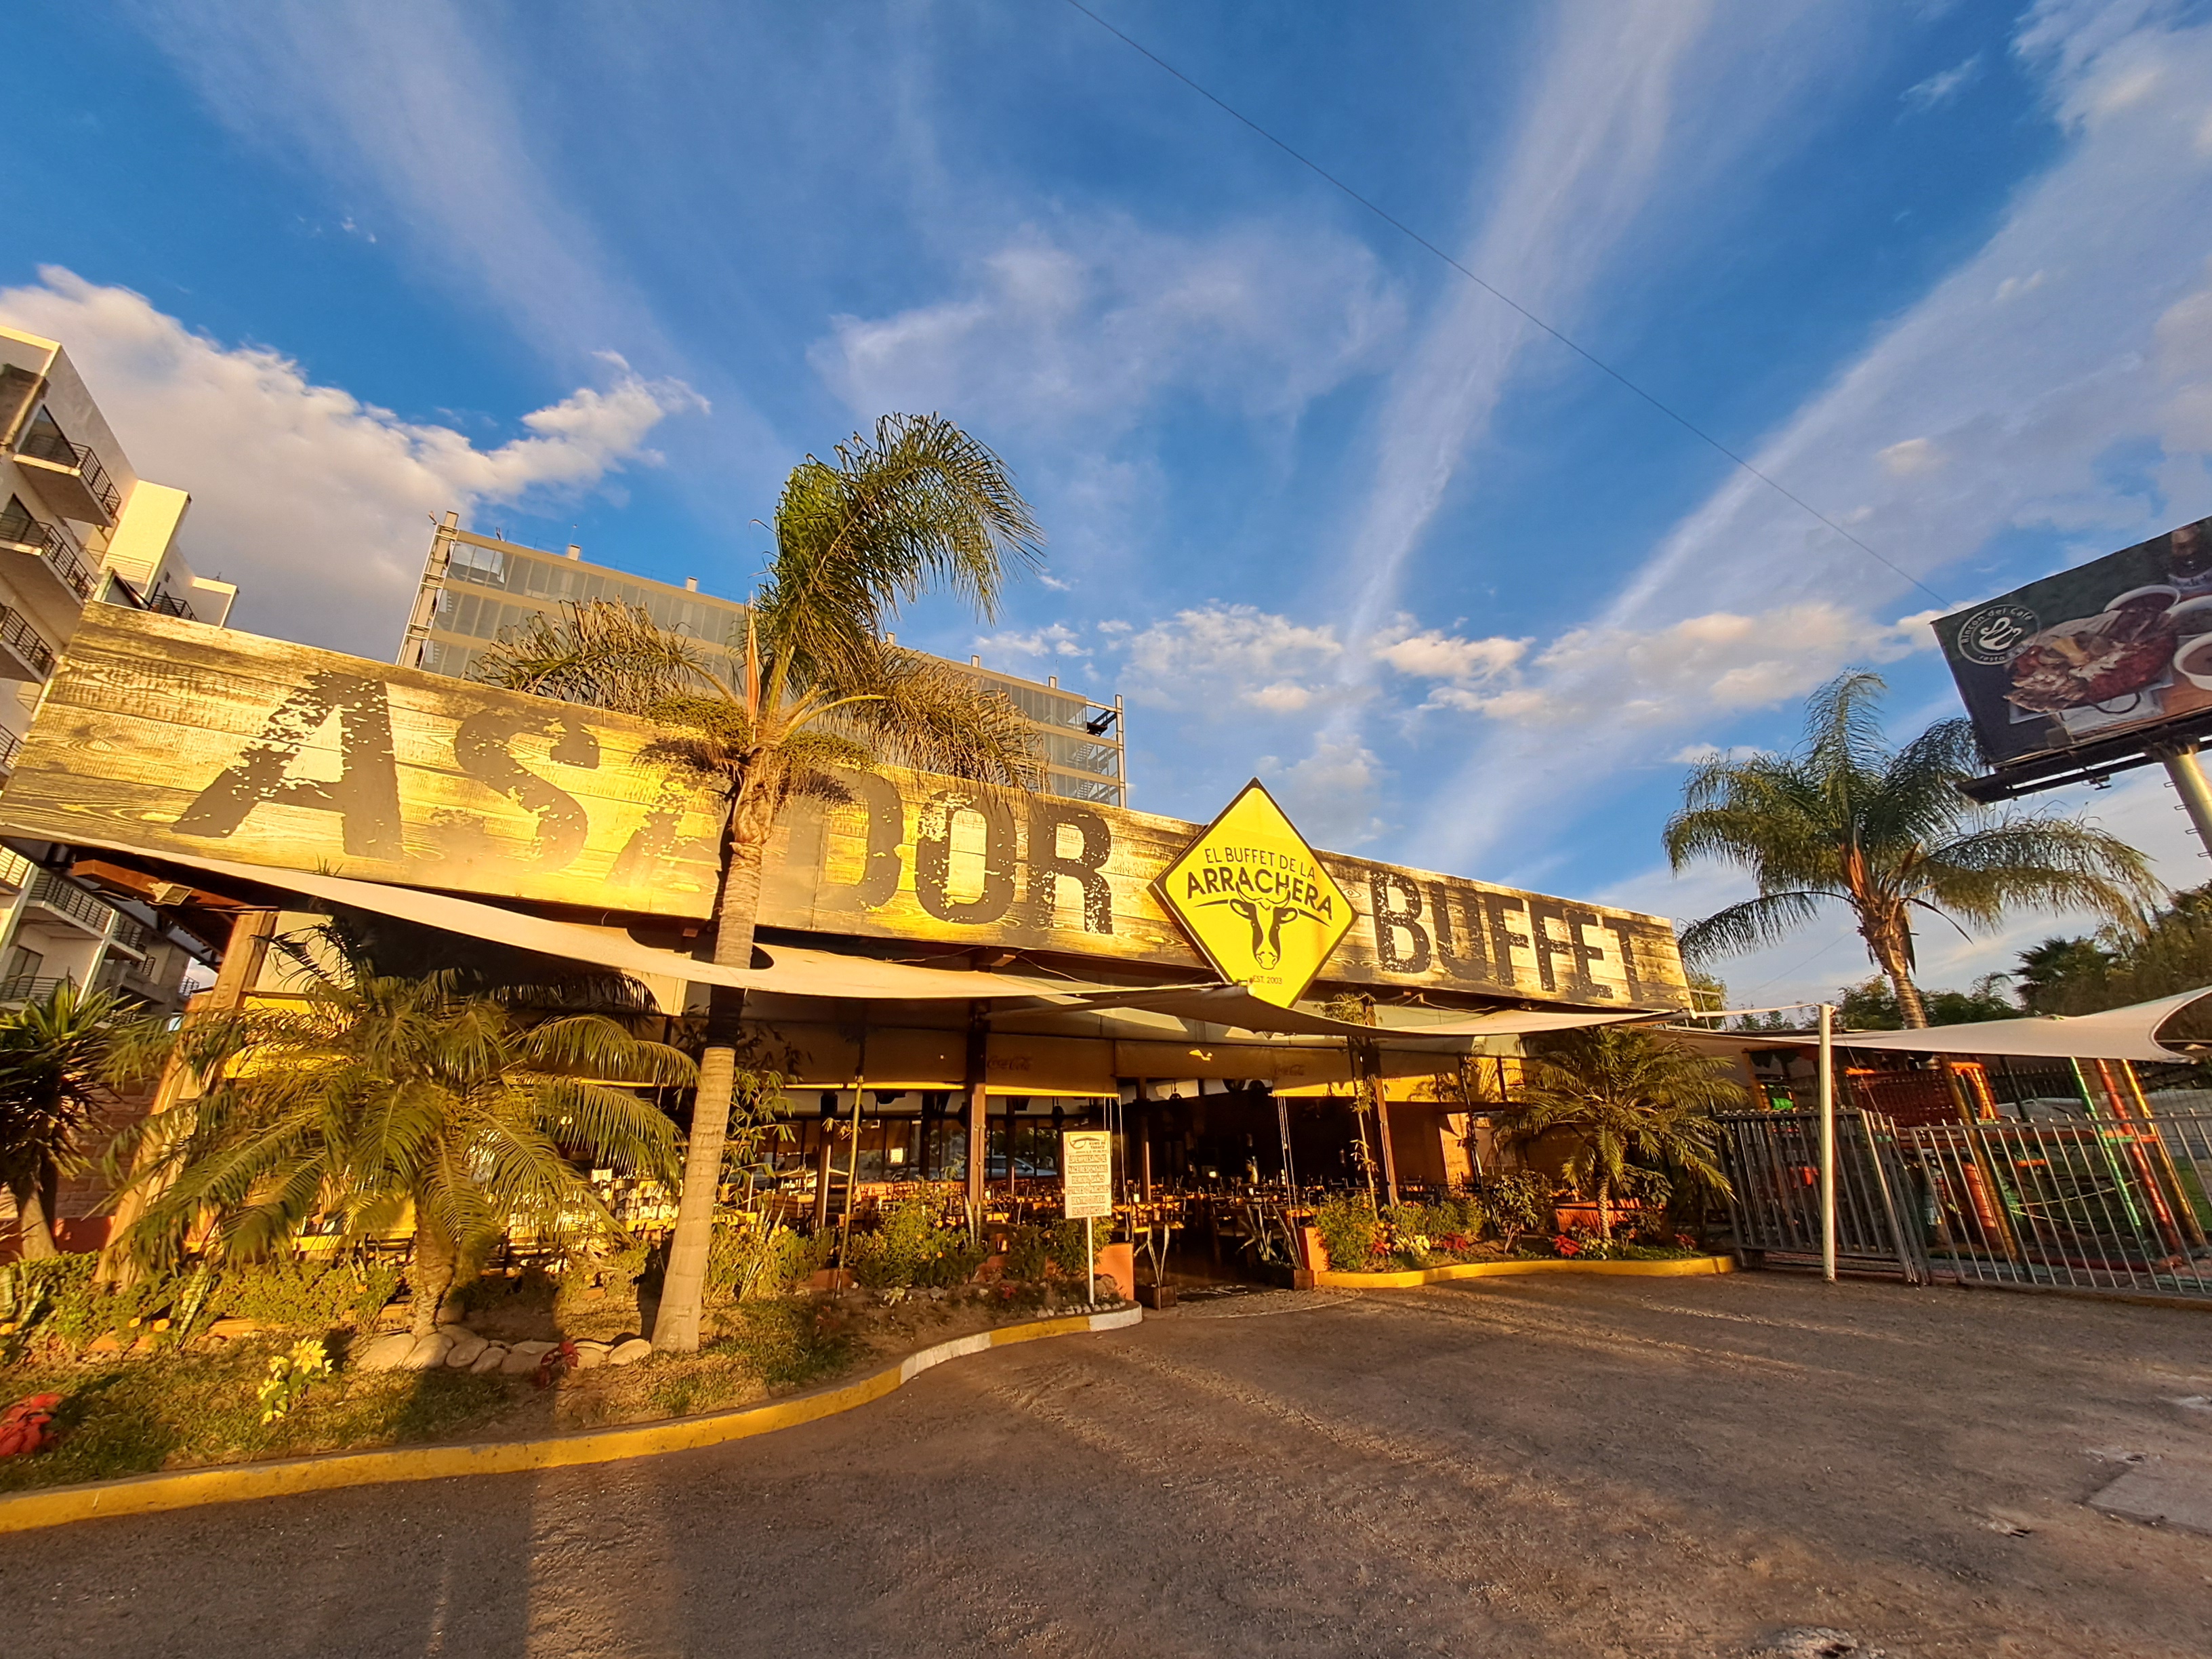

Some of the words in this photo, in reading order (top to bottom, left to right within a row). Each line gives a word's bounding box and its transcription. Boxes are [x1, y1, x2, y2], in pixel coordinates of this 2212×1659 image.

[1988, 607, 2006, 617] del
[171, 668, 1113, 935] ASADOR
[1369, 871, 1648, 1002] BUFFET
[1204, 848, 1223, 863] EL
[1225, 847, 1275, 867] BUFFET
[1279, 855, 1297, 873] DE
[1300, 862, 1315, 881] LA
[1187, 867, 1333, 921] ARRACHERA
[1252, 975, 1264, 983] EST.
[1267, 977, 1283, 985] 2003
